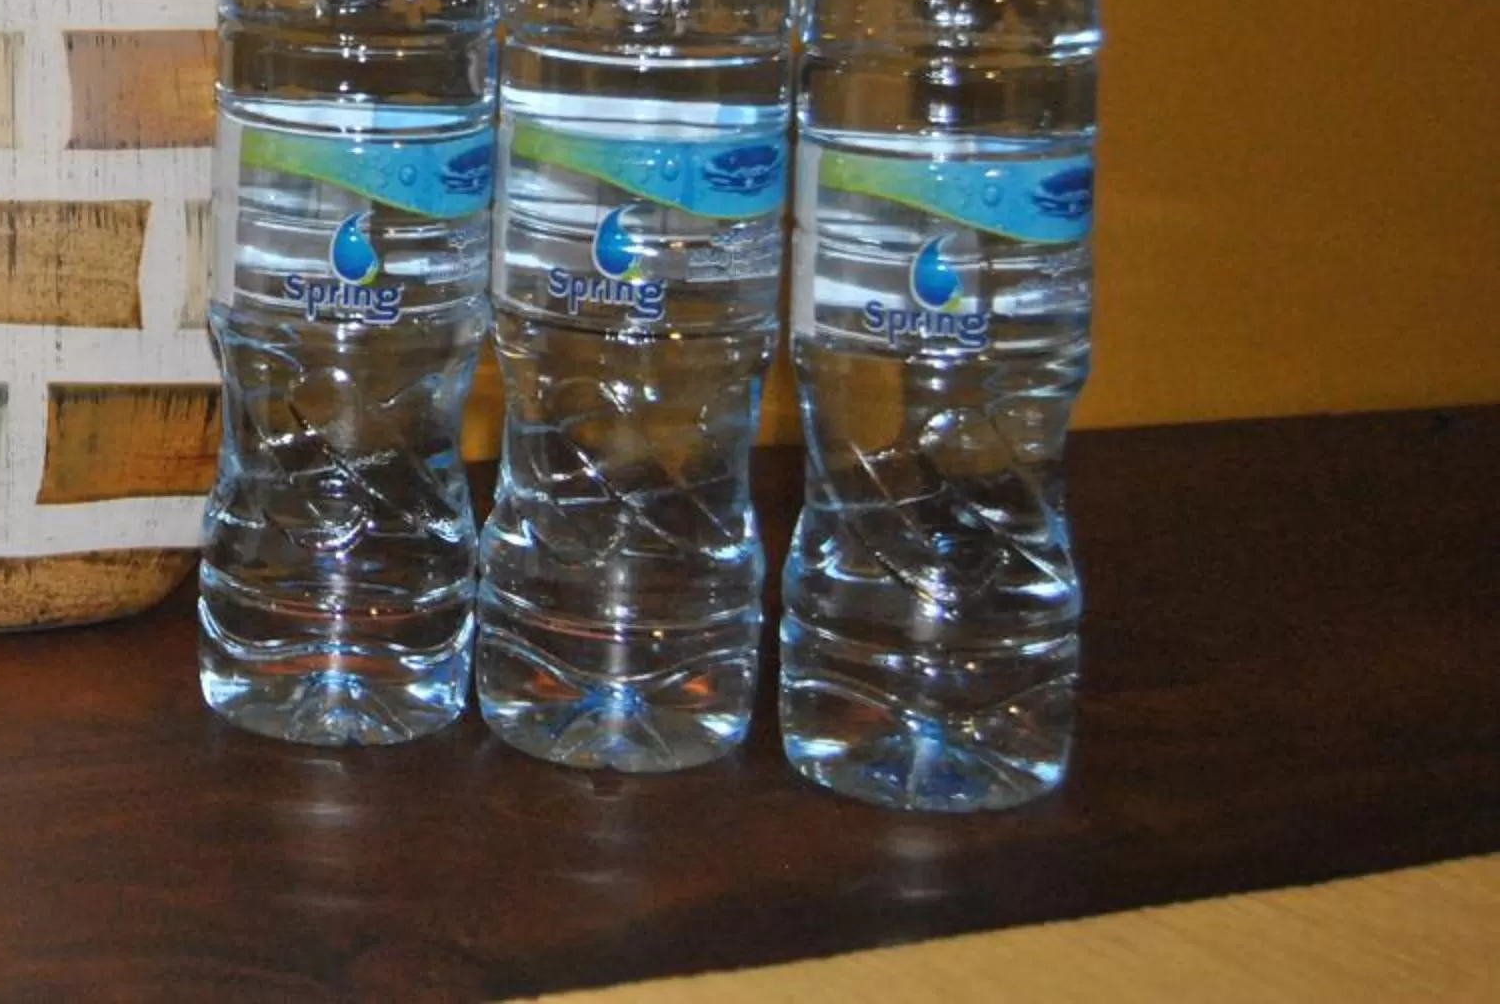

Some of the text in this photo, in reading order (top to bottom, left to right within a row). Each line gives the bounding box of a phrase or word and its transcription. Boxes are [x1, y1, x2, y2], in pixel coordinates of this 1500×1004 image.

[283, 273, 405, 325] Spring
[547, 267, 667, 322] Spring
[862, 299, 990, 352] Spring
